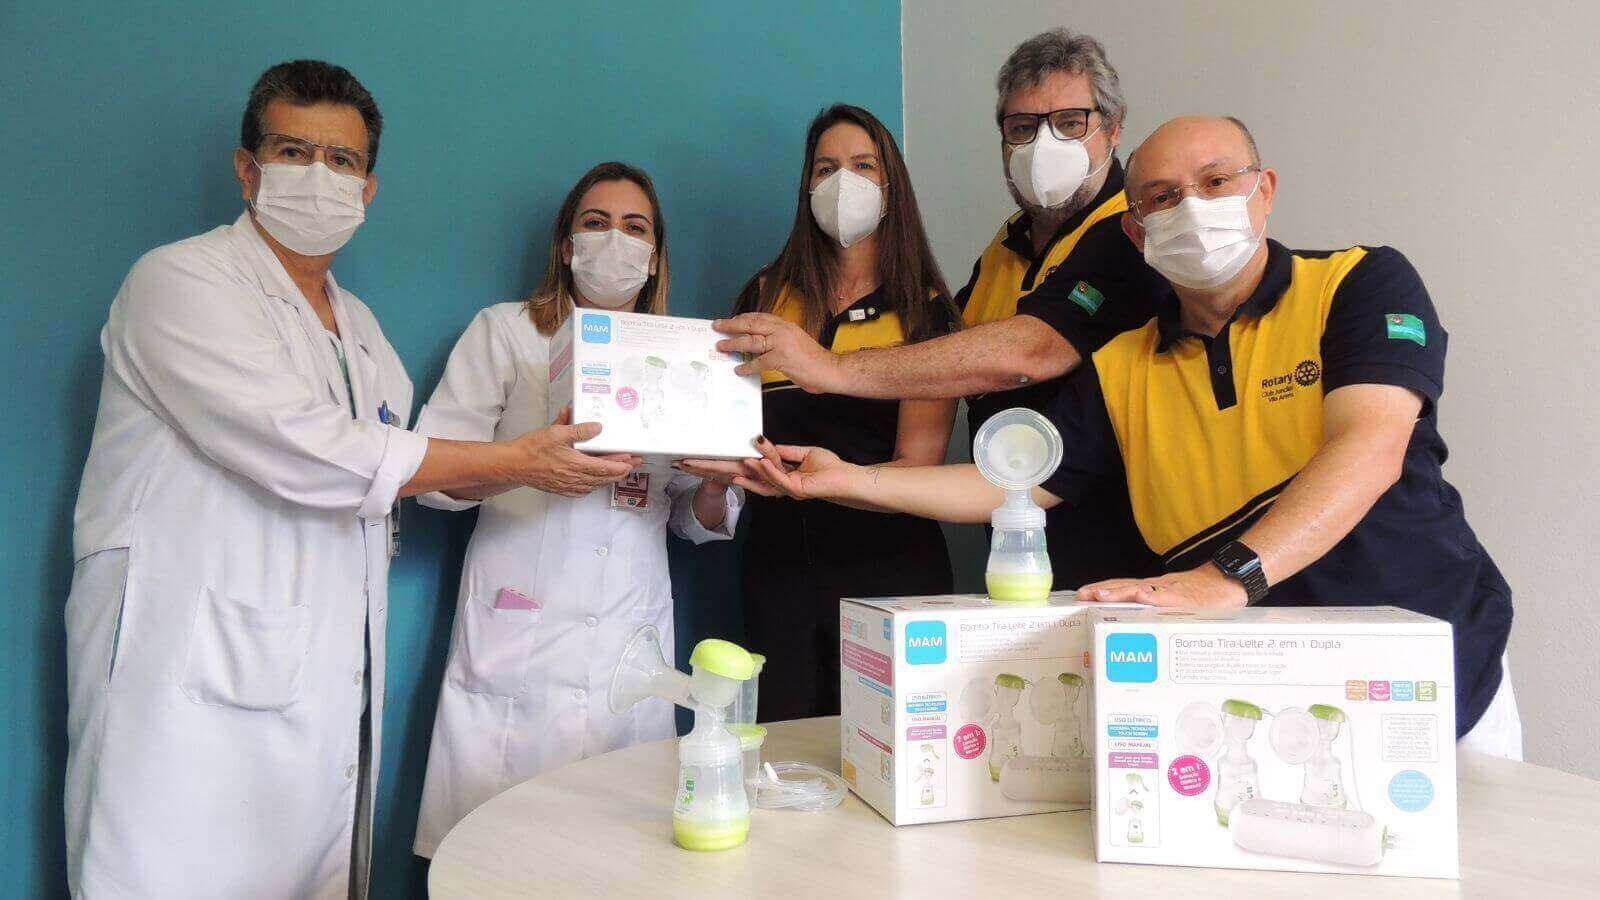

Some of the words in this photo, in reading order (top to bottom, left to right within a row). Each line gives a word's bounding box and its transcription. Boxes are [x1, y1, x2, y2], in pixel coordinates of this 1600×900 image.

[583, 324, 609, 335] MAM
[1262, 373, 1292, 388] Rotary
[1059, 619, 1081, 629] Dupla
[908, 636, 943, 648] MAM
[1175, 638, 1213, 649] Bomba
[1217, 638, 1264, 649] Tira-Leite
[1267, 639, 1275, 649] 2
[1279, 640, 1297, 649] em
[1310, 639, 1341, 651] Dupla
[1110, 650, 1153, 663] MAM
[1171, 767, 1178, 776] 2
